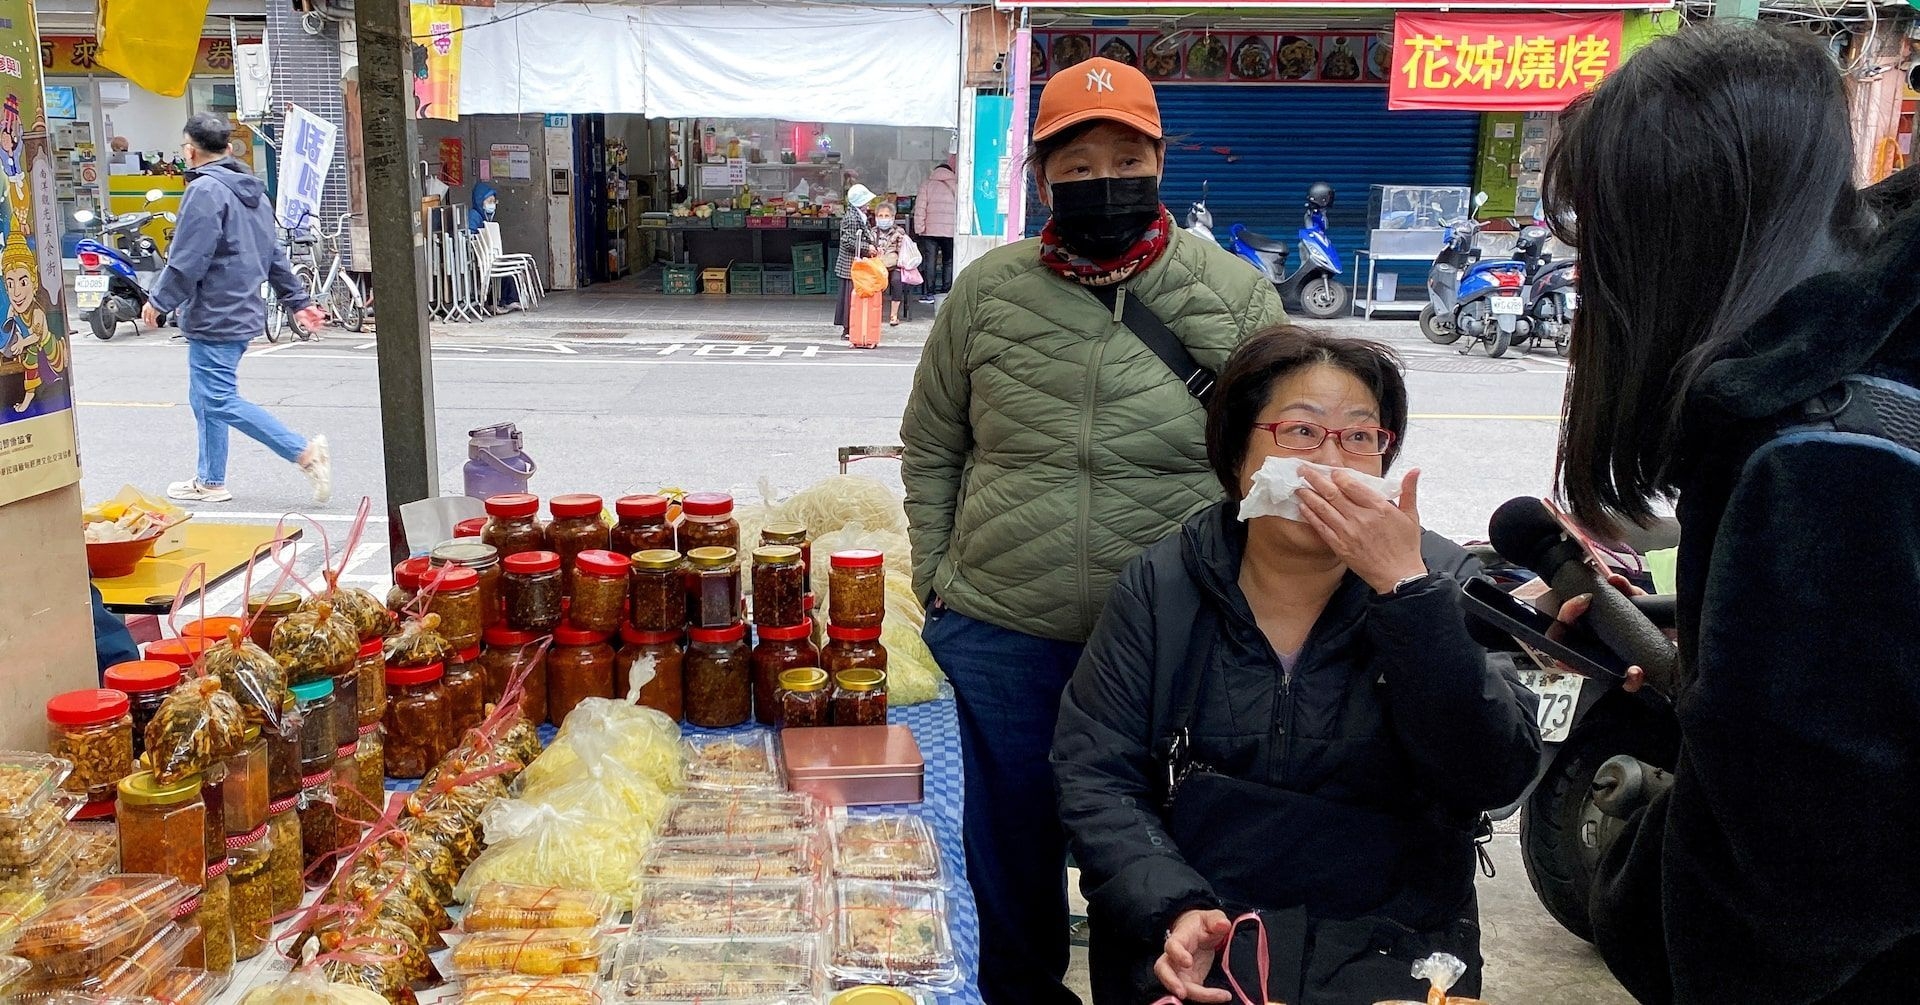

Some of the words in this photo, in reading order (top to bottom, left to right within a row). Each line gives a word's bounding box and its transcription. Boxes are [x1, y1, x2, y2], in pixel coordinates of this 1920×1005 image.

[1086, 68, 1114, 92] NY
[1401, 34, 1611, 90] 花姊燒烤
